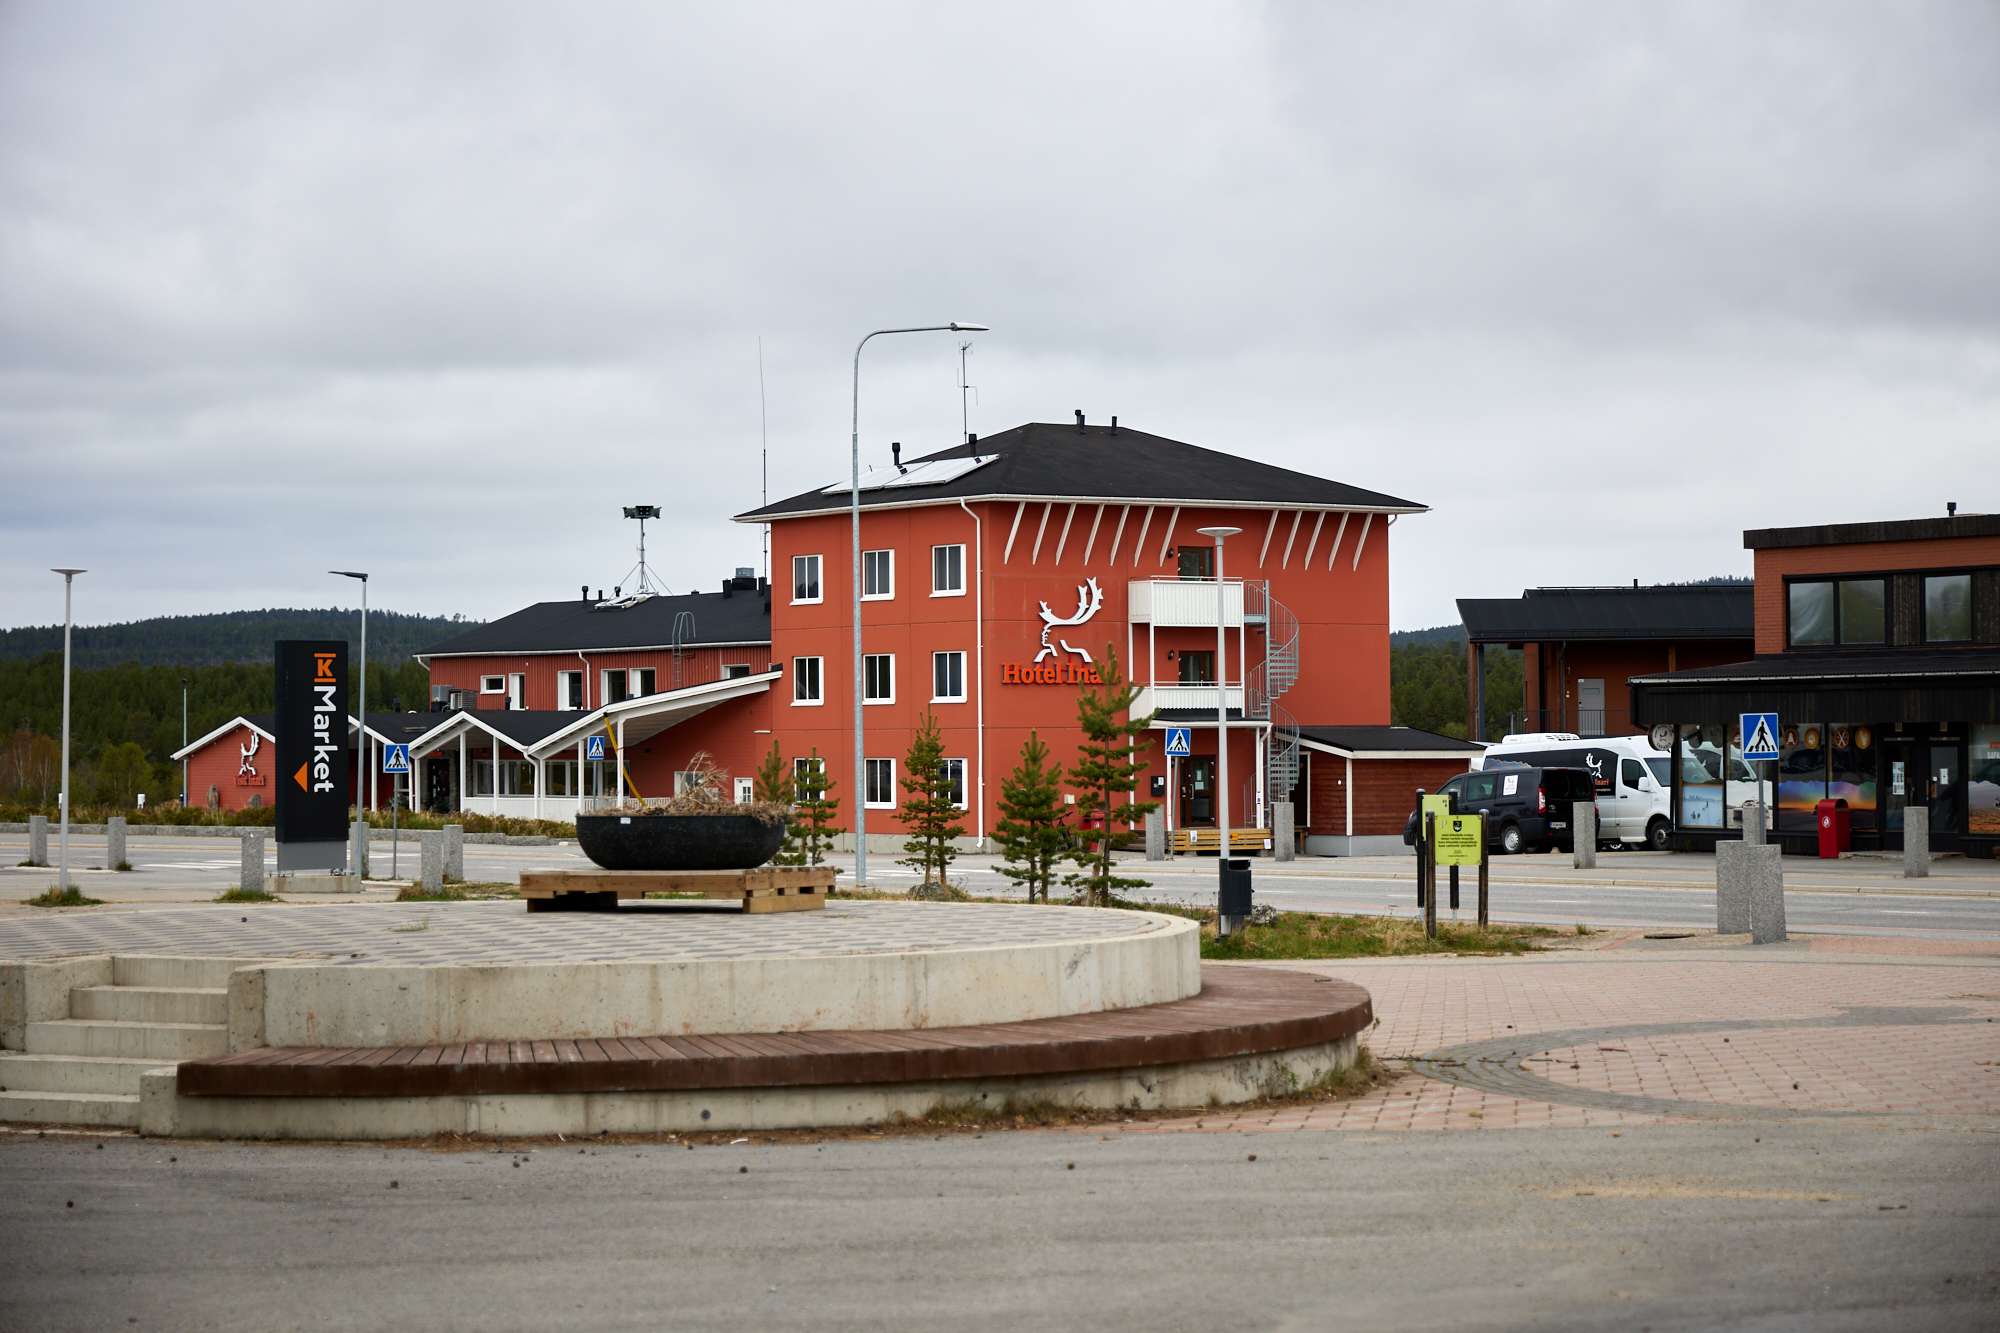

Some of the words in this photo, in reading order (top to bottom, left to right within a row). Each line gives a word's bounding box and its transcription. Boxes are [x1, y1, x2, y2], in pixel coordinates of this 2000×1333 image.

[315, 657, 335, 679] K
[1002, 661, 1063, 684] Hotel
[1066, 662, 1119, 684] Ina
[313, 685, 338, 793] Market
